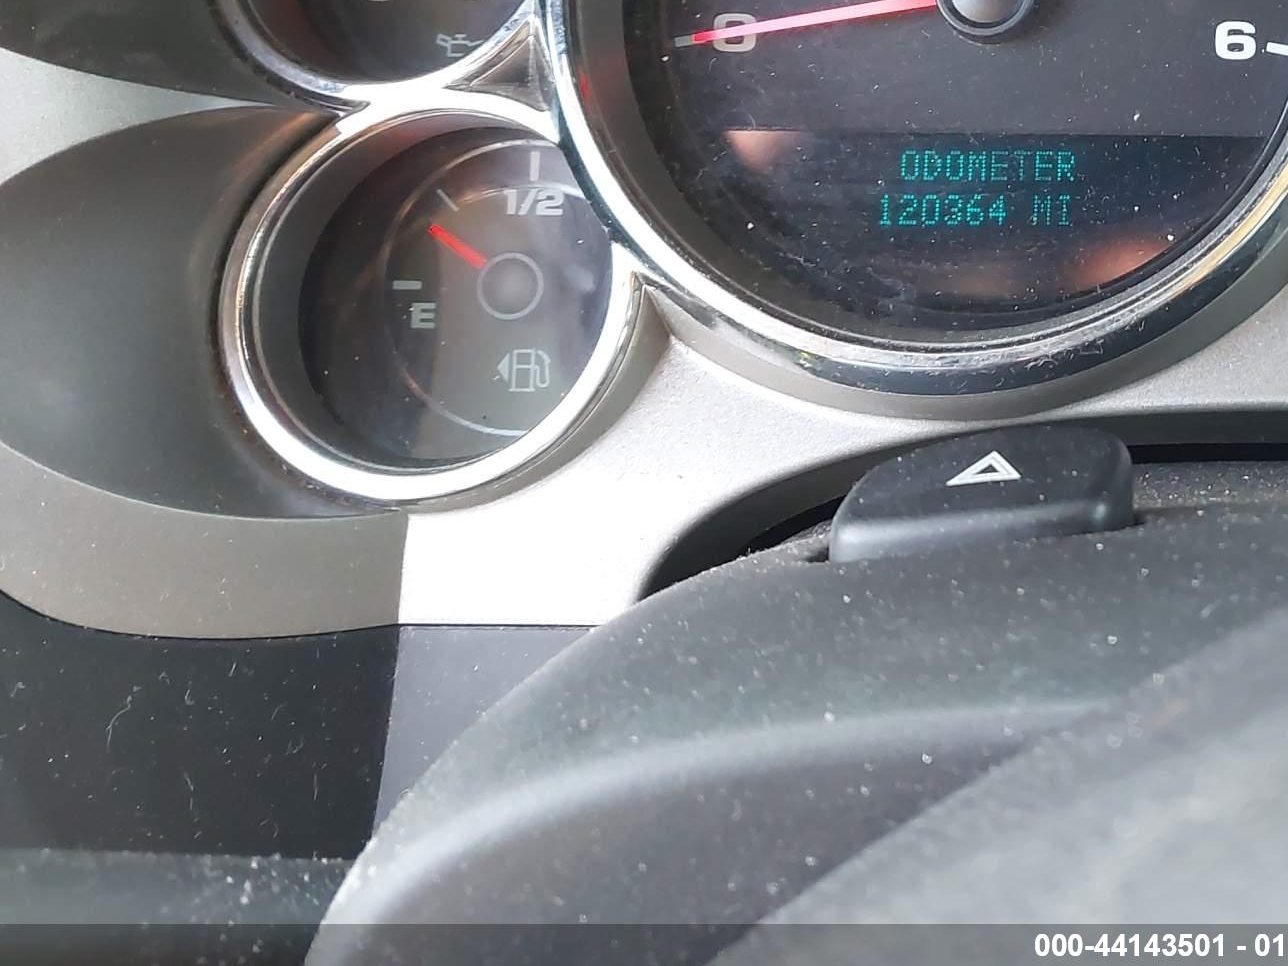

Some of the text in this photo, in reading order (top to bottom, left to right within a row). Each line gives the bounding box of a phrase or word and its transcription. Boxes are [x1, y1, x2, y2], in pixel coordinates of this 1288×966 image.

[712, 13, 757, 53] 0
[1214, 21, 1256, 61] 6
[900, 150, 1075, 181] ODOMETER
[504, 189, 564, 216] 1/2
[879, 194, 1071, 226] 120364 MI
[411, 302, 436, 329] E
